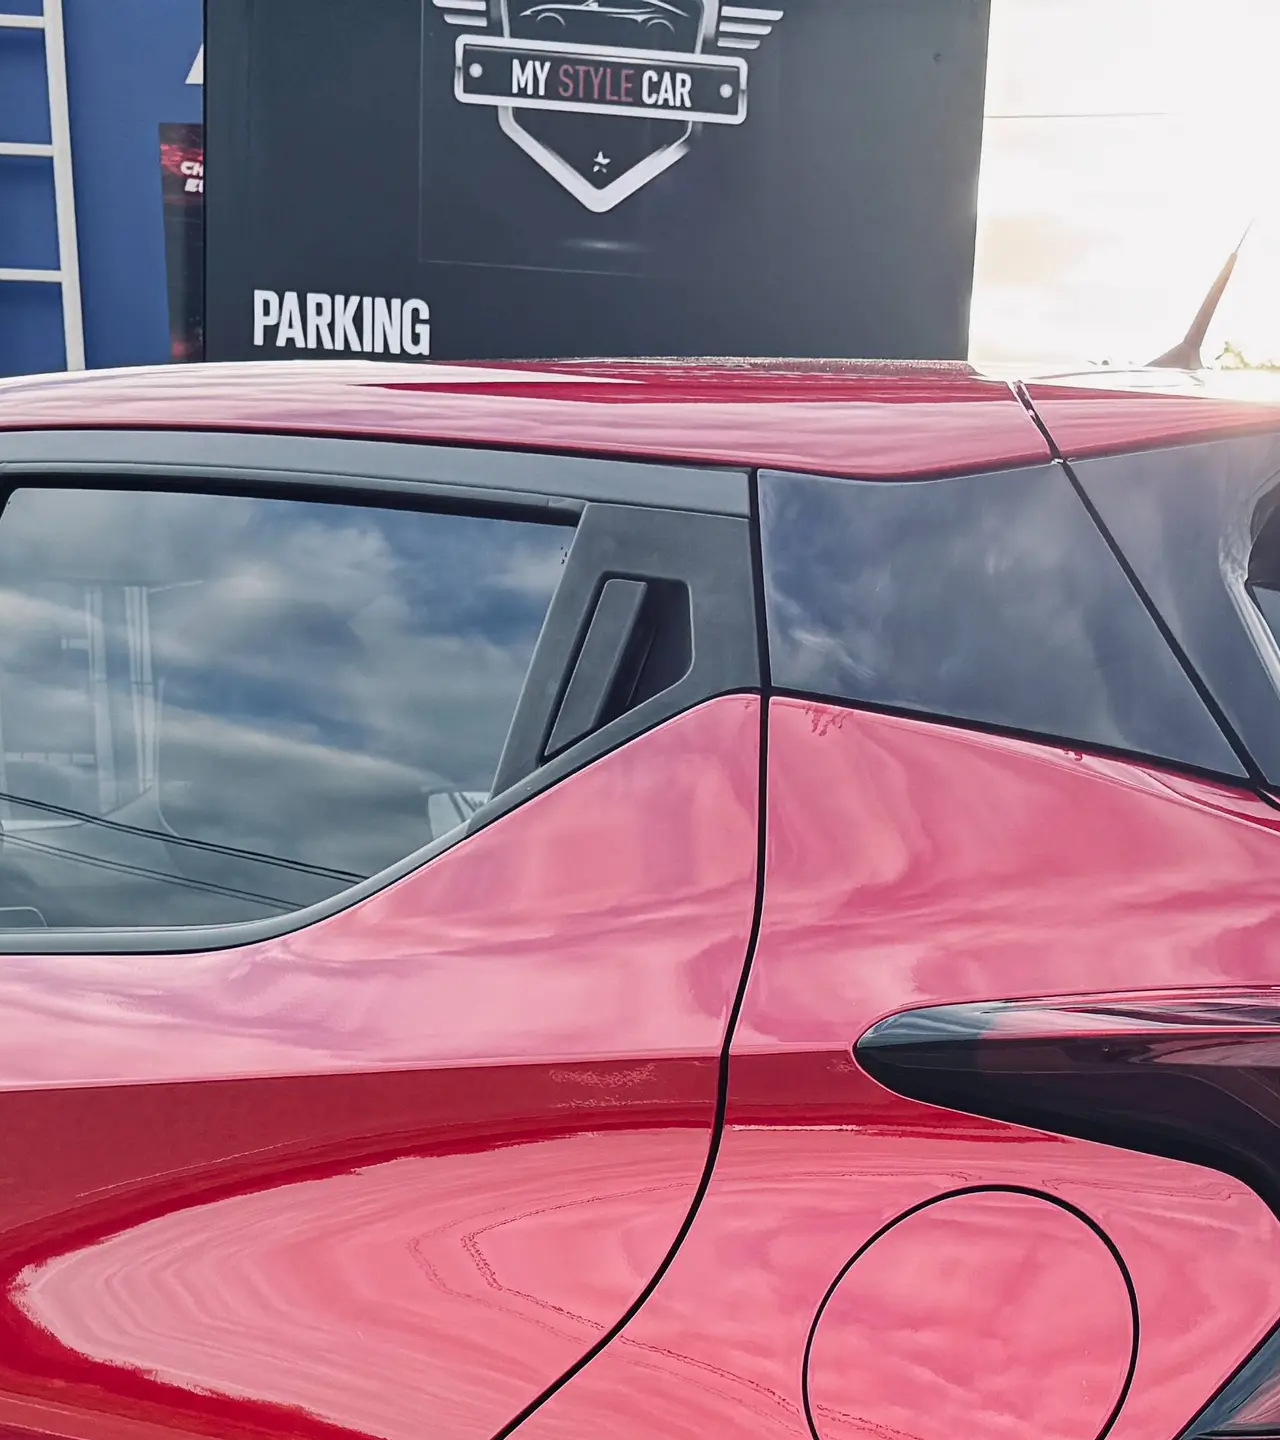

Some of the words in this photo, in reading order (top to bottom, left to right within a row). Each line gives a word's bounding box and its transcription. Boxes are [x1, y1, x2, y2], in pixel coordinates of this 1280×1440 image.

[511, 58, 552, 97] MY
[558, 64, 636, 103] STYLE
[641, 70, 693, 108] CAR
[253, 289, 431, 356] PARKING
